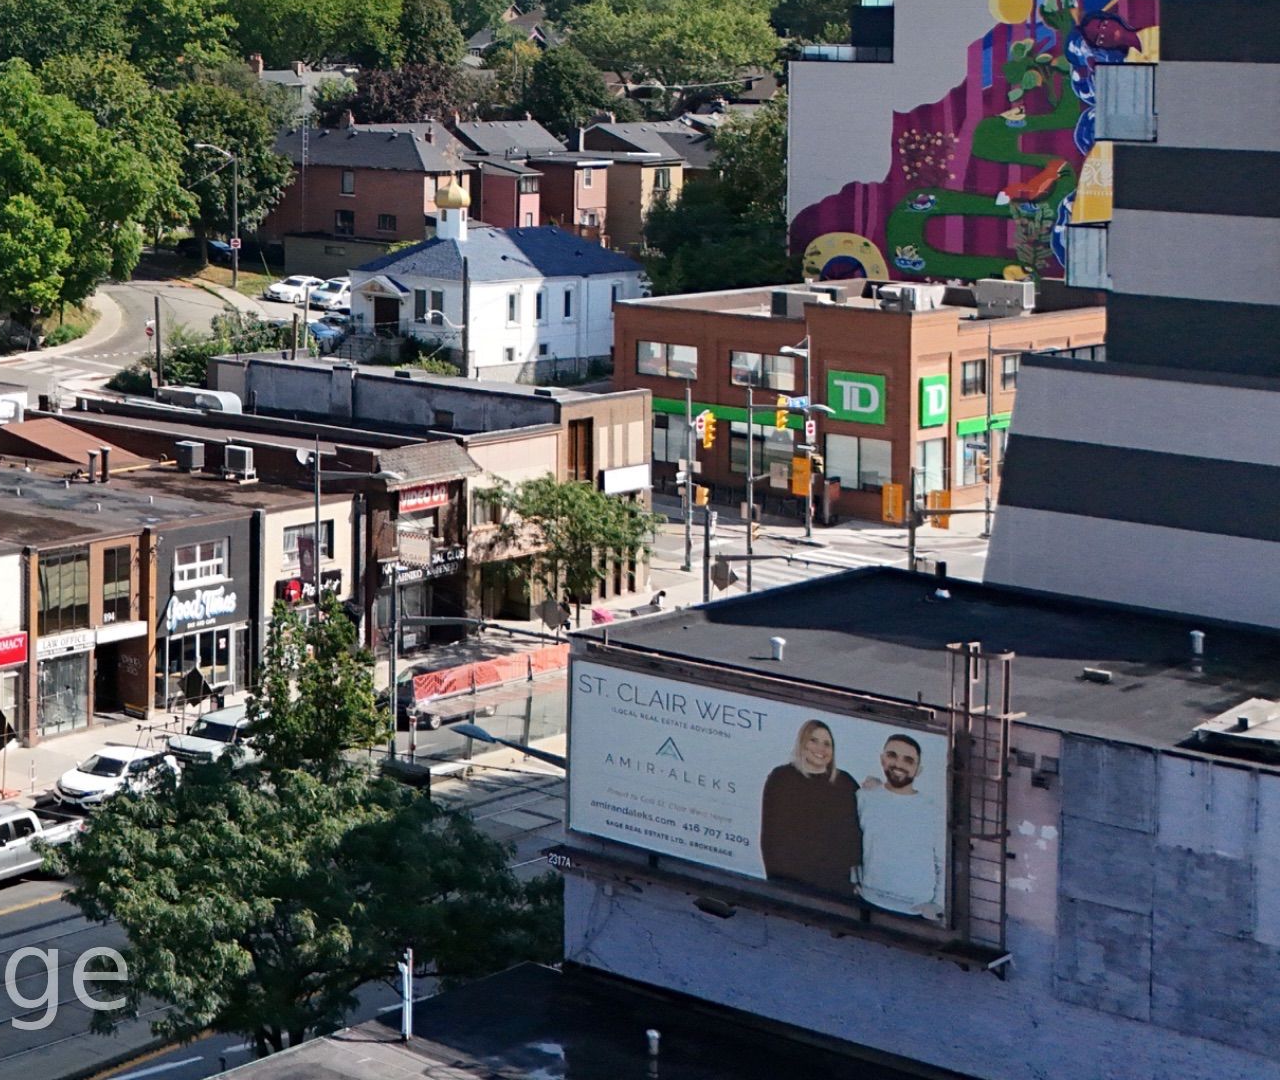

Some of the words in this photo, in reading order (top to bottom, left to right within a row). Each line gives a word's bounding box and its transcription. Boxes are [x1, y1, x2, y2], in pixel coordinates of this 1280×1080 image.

[834, 379, 880, 413] TD
[924, 384, 946, 416] TD
[447, 548, 465, 560] CLUB
[167, 589, 204, 631] Good
[42, 637, 58, 650] LAW
[60, 633, 87, 648] OFFICE
[578, 673, 609, 698] ST.
[616, 683, 687, 715] CLAIR
[695, 698, 768, 731] WEST
[640, 713, 659, 723] REAL
[661, 717, 688, 730] ESTATE
[590, 798, 677, 828] amirandaleks.com
[682, 822, 700, 834] 416
[704, 826, 722, 839] 707
[725, 832, 750, 847] 1209
[625, 822, 642, 834] REAL
[644, 827, 670, 841] ESTATE
[548, 852, 571, 868] 2317A
